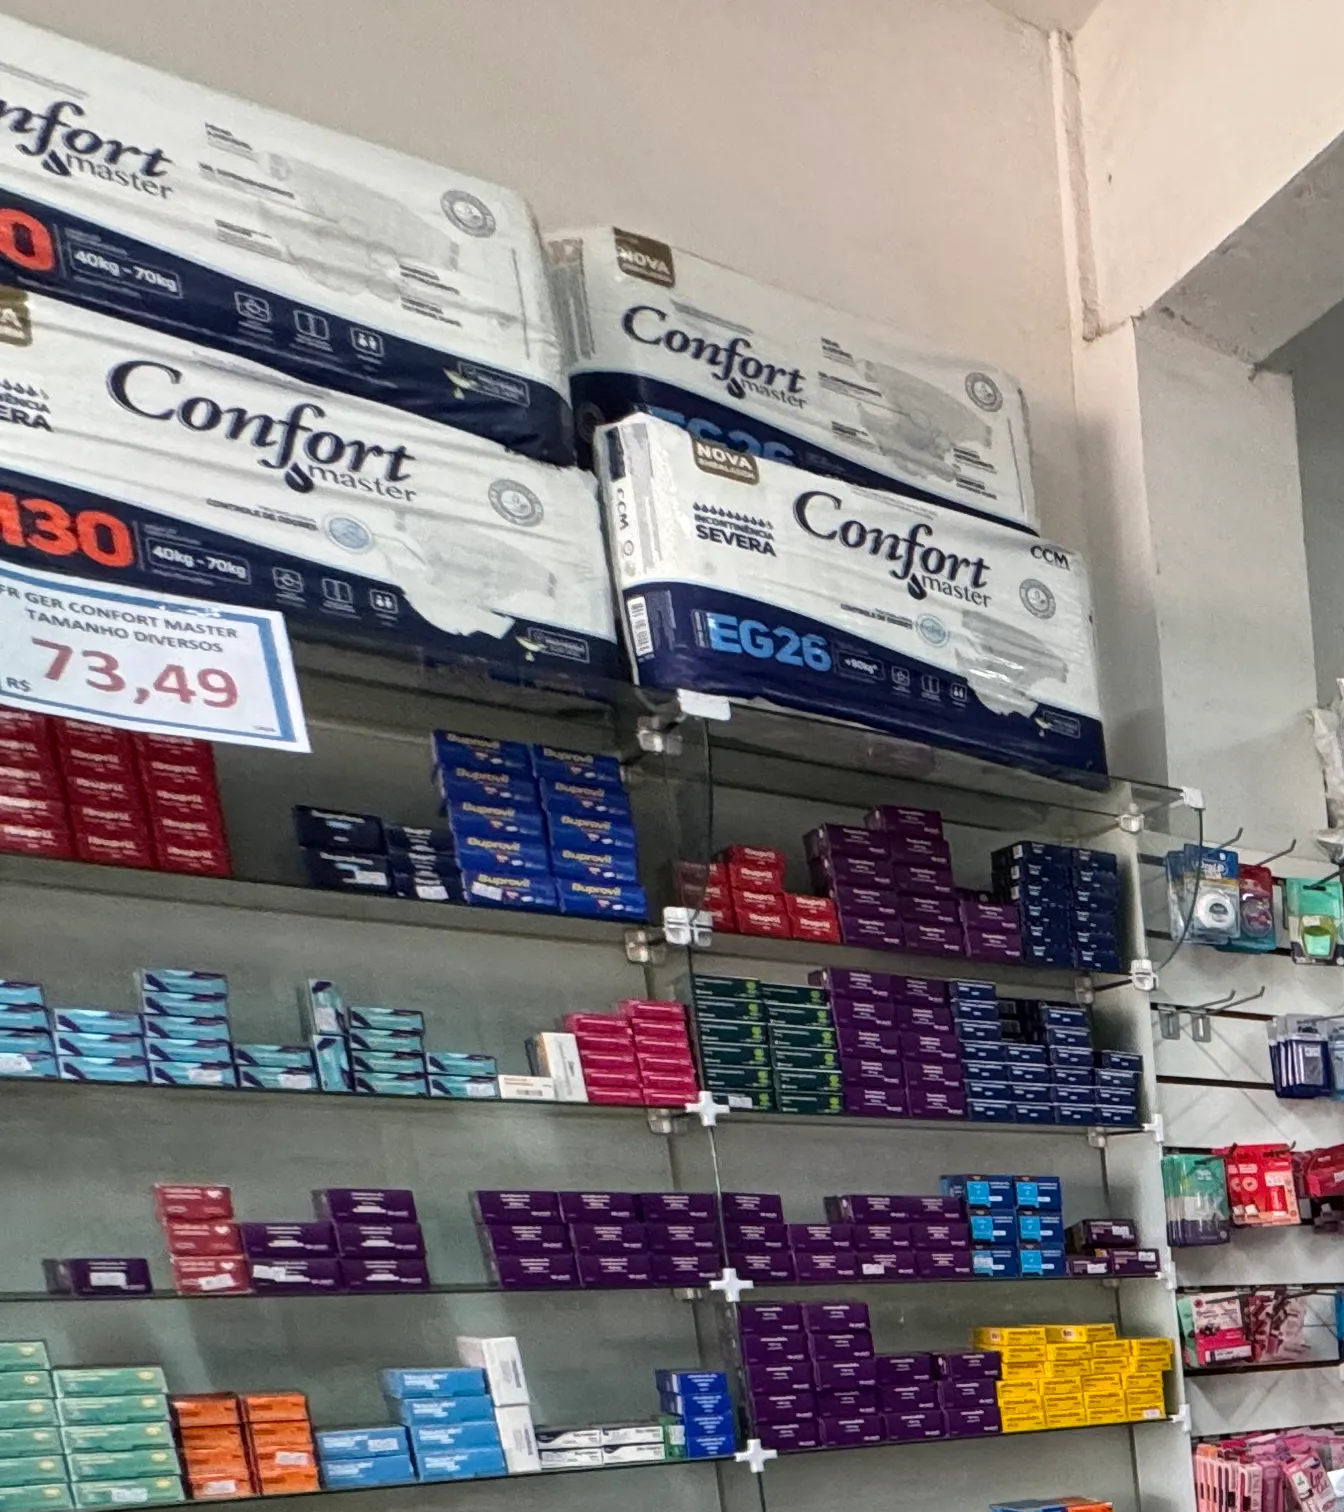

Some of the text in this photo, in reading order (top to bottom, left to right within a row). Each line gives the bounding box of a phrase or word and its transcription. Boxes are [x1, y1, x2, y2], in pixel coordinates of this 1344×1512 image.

[66, 152, 174, 199] master
[619, 245, 672, 277] NOVA
[622, 305, 806, 395] Confort
[739, 378, 806, 410] master
[106, 360, 416, 483] Confort
[697, 442, 753, 471] NOVA
[309, 461, 417, 503] master
[695, 525, 777, 557] SEVERA
[793, 491, 990, 588] Confort
[1030, 544, 1071, 570] CCM
[153, 545, 248, 580] 40kg 70kg
[921, 573, 992, 608] master
[24, 589, 239, 640] GER CONFORT MASTER
[27, 607, 224, 654] TAMANHO DIVERSOS
[711, 611, 833, 673] EG26
[6, 676, 32, 694] R$
[32, 635, 239, 709] 73,49
